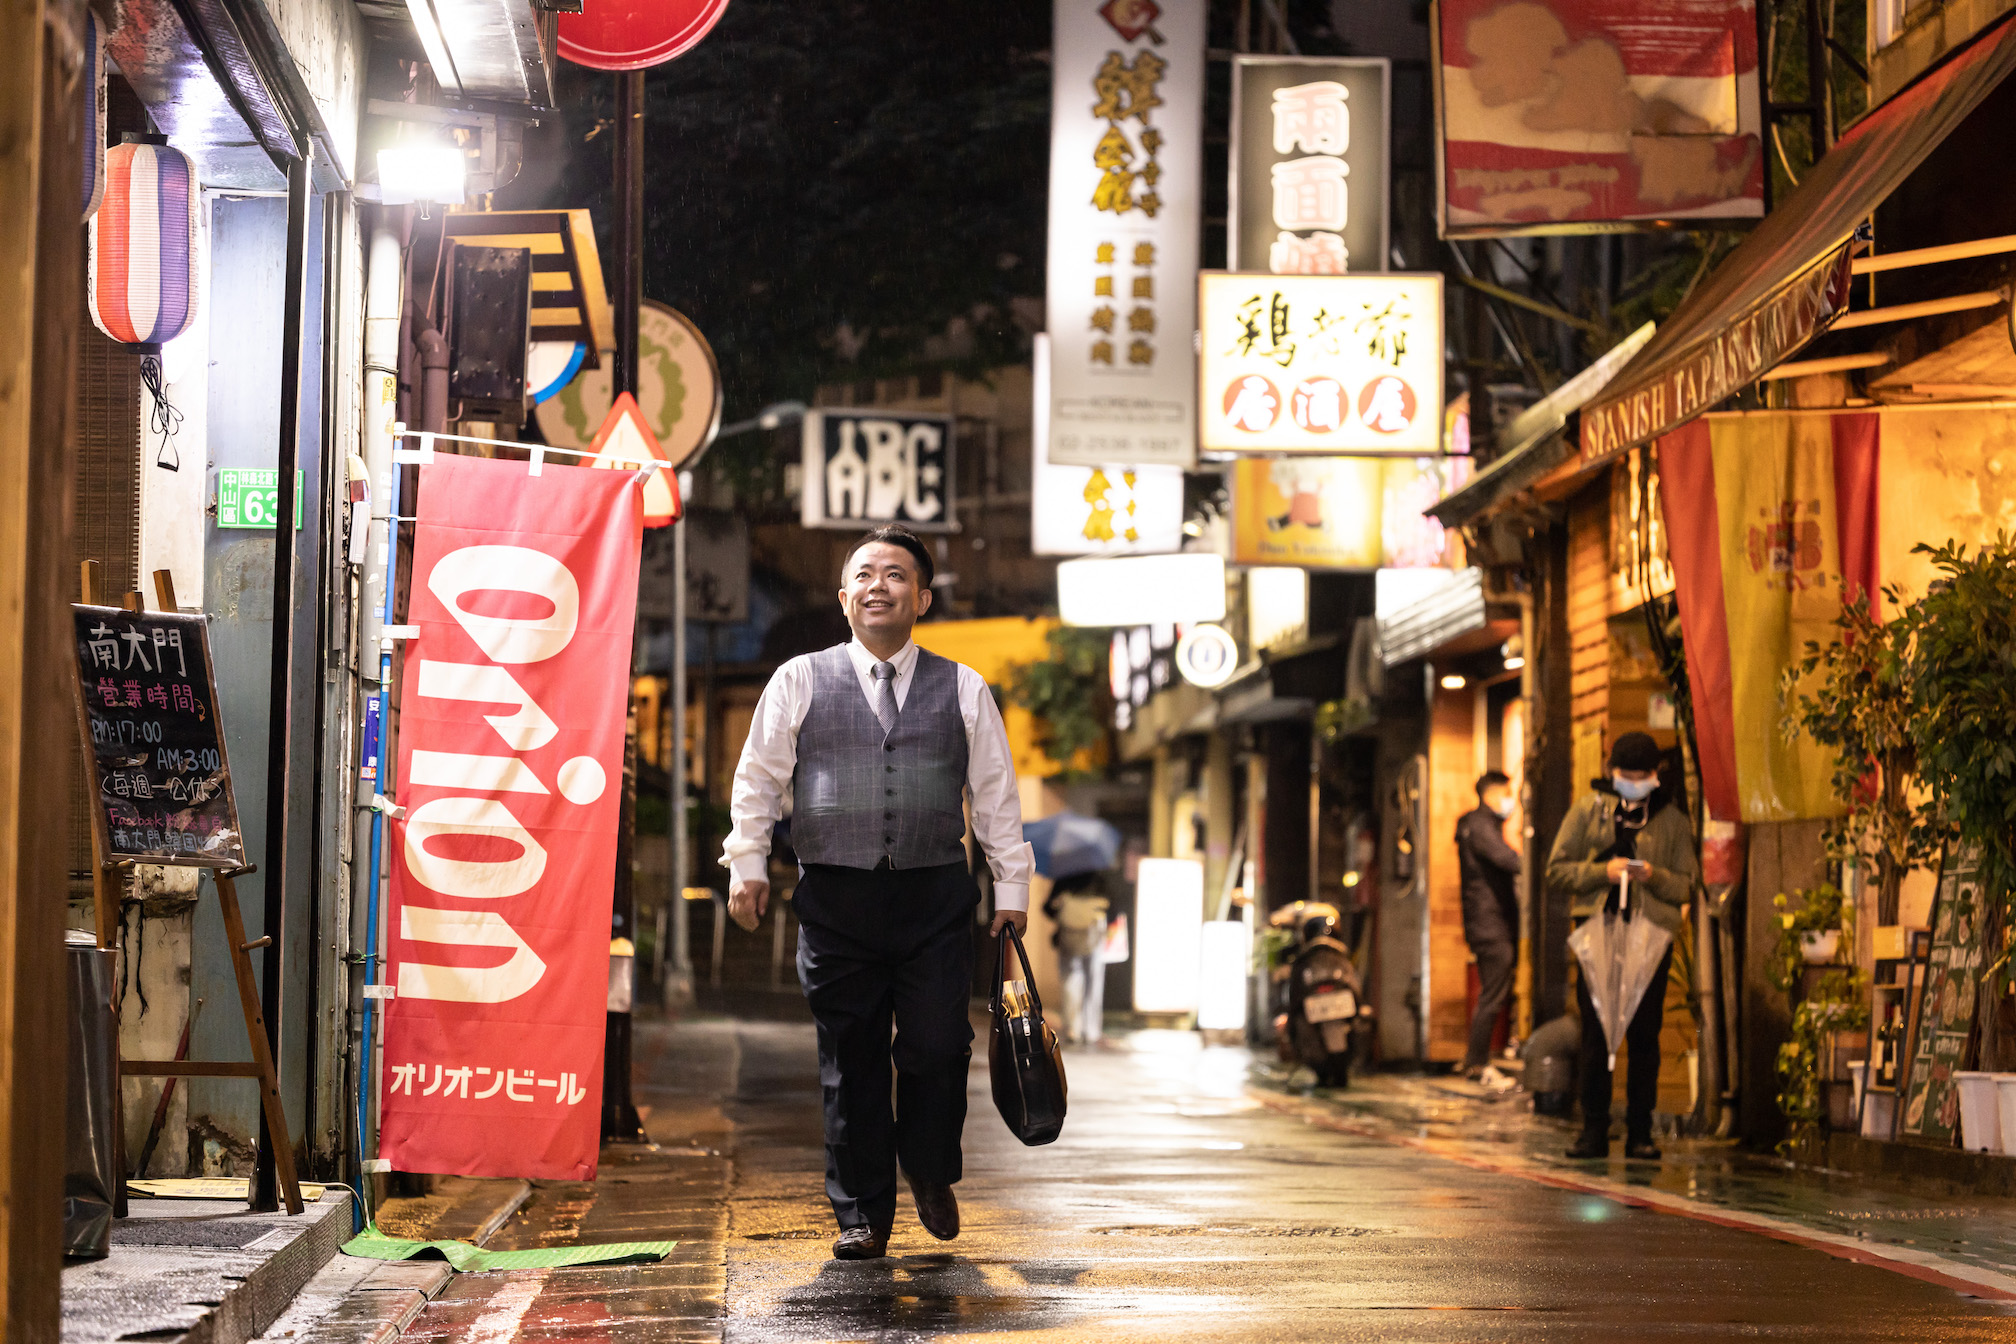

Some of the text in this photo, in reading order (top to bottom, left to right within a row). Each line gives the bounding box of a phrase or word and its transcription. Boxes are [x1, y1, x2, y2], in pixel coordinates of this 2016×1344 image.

[1586, 382, 1666, 460] SPANISH
[827, 419, 942, 521] ABC
[222, 472, 238, 523] 中山區
[88, 621, 187, 677] 南大門
[97, 677, 195, 713] 營業時間
[91, 718, 162, 744] PM:17:00
[157, 747, 220, 771] AM:3:00
[390, 1062, 587, 1105] オリオンビール
